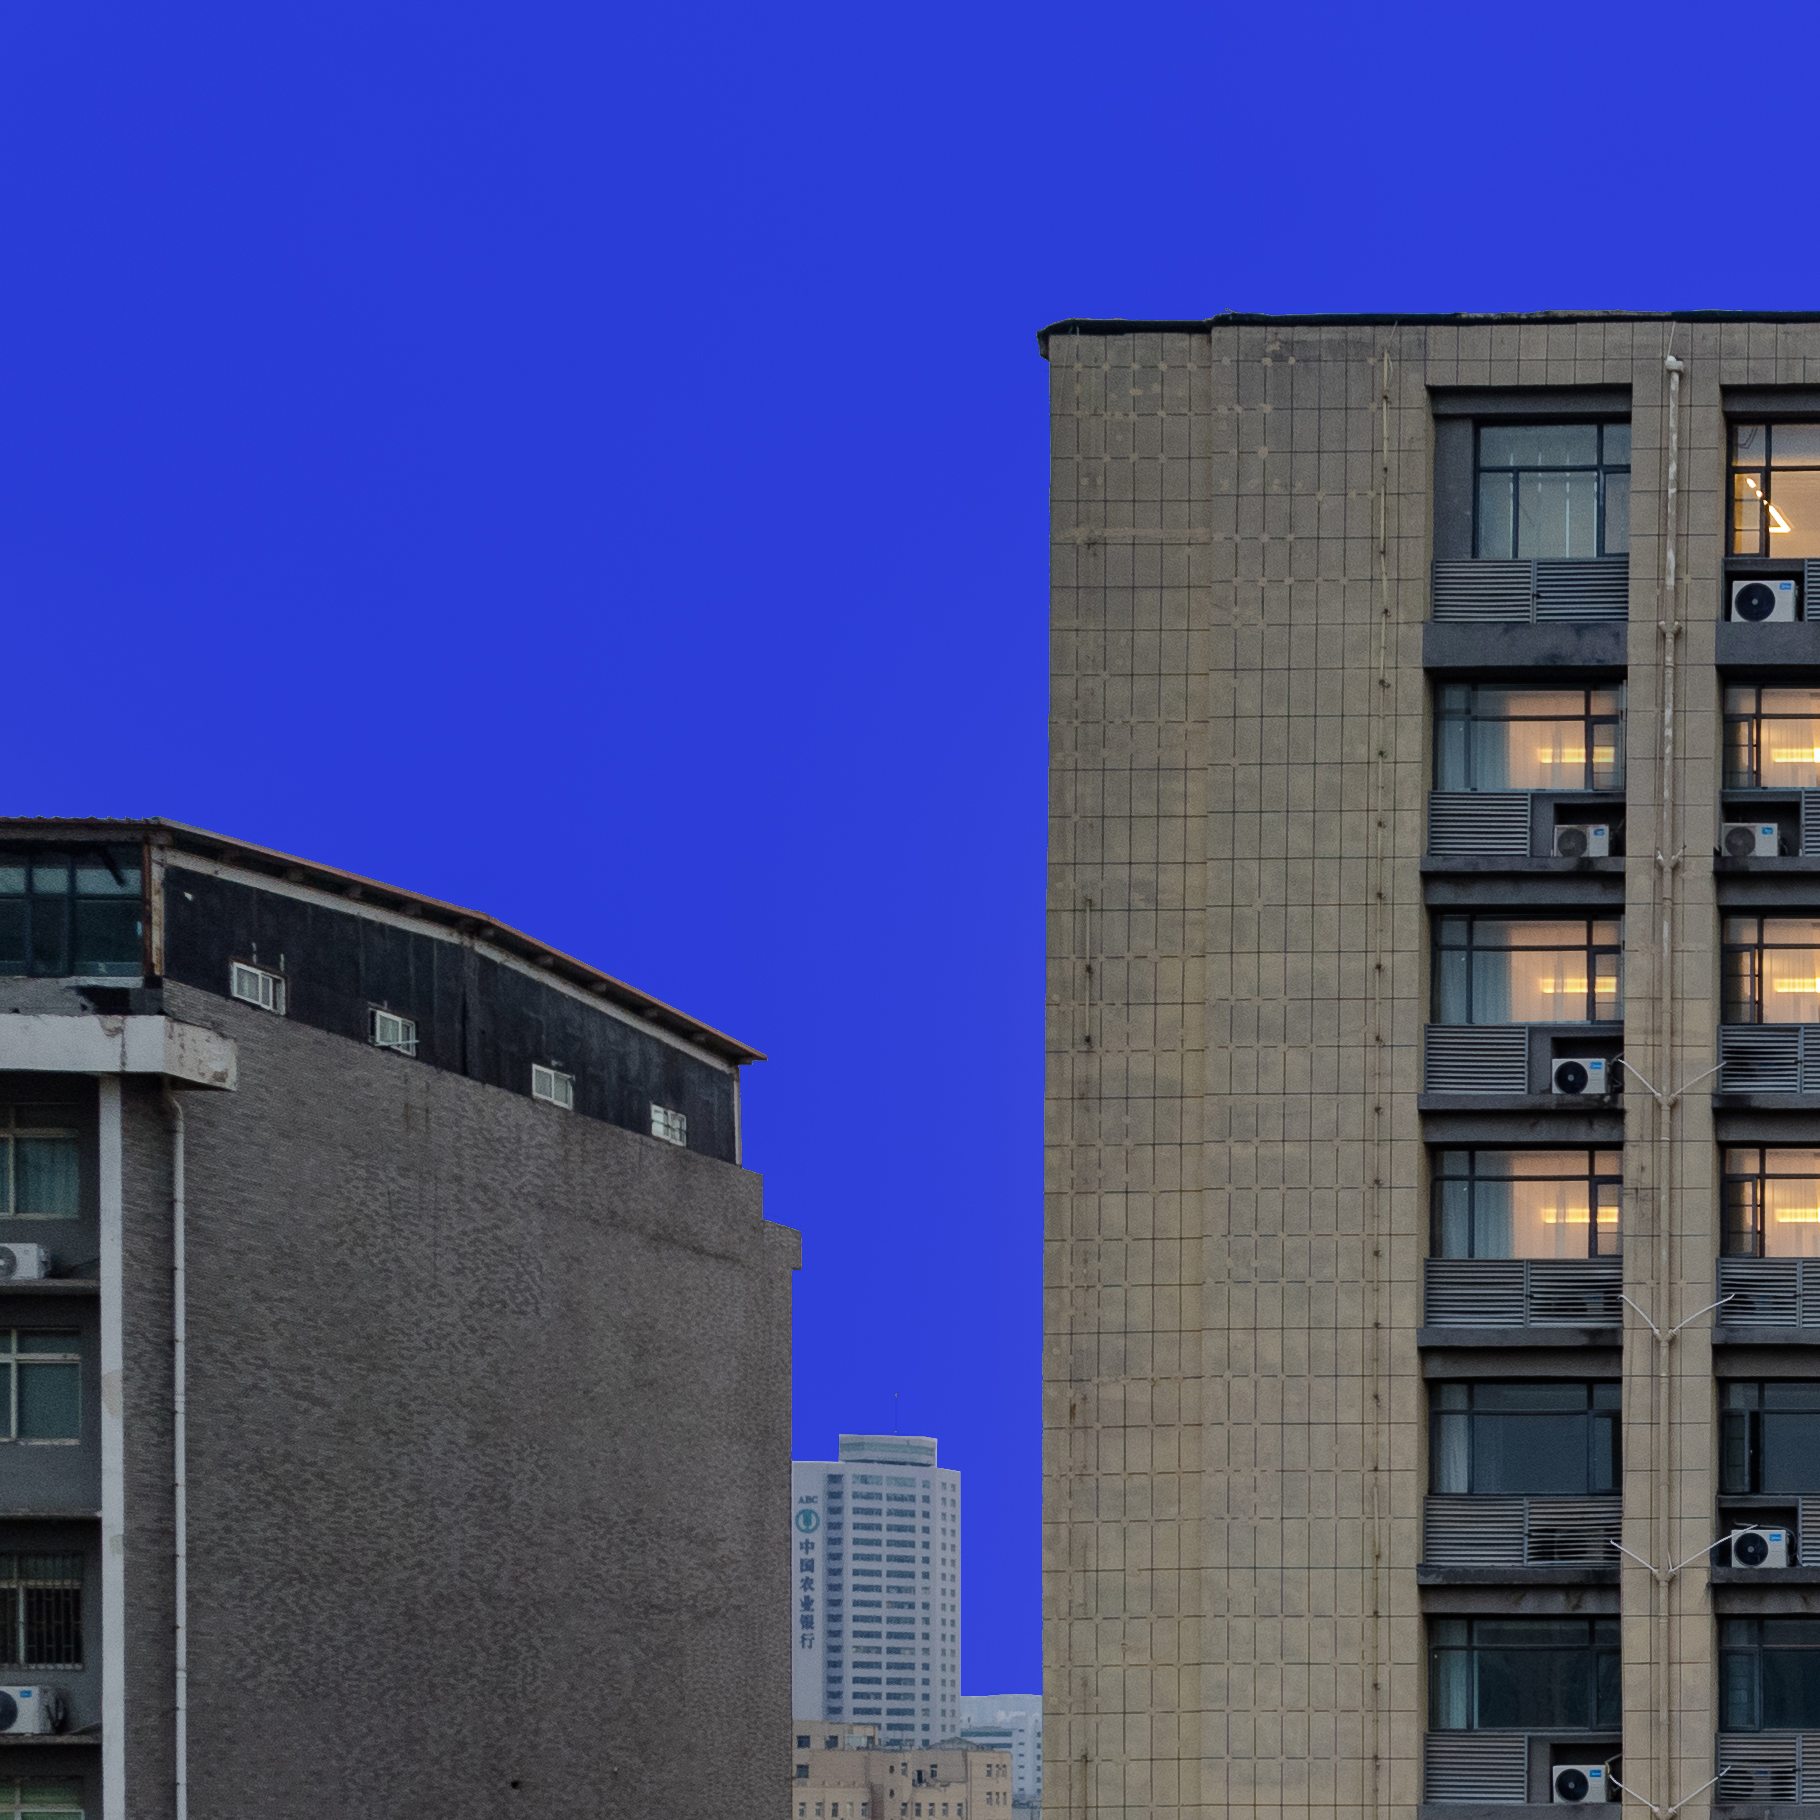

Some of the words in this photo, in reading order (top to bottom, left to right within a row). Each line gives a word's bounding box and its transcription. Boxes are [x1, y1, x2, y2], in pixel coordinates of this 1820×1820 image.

[798, 1495, 818, 1504] ABC
[799, 1538, 815, 1649] 中国农业银行
